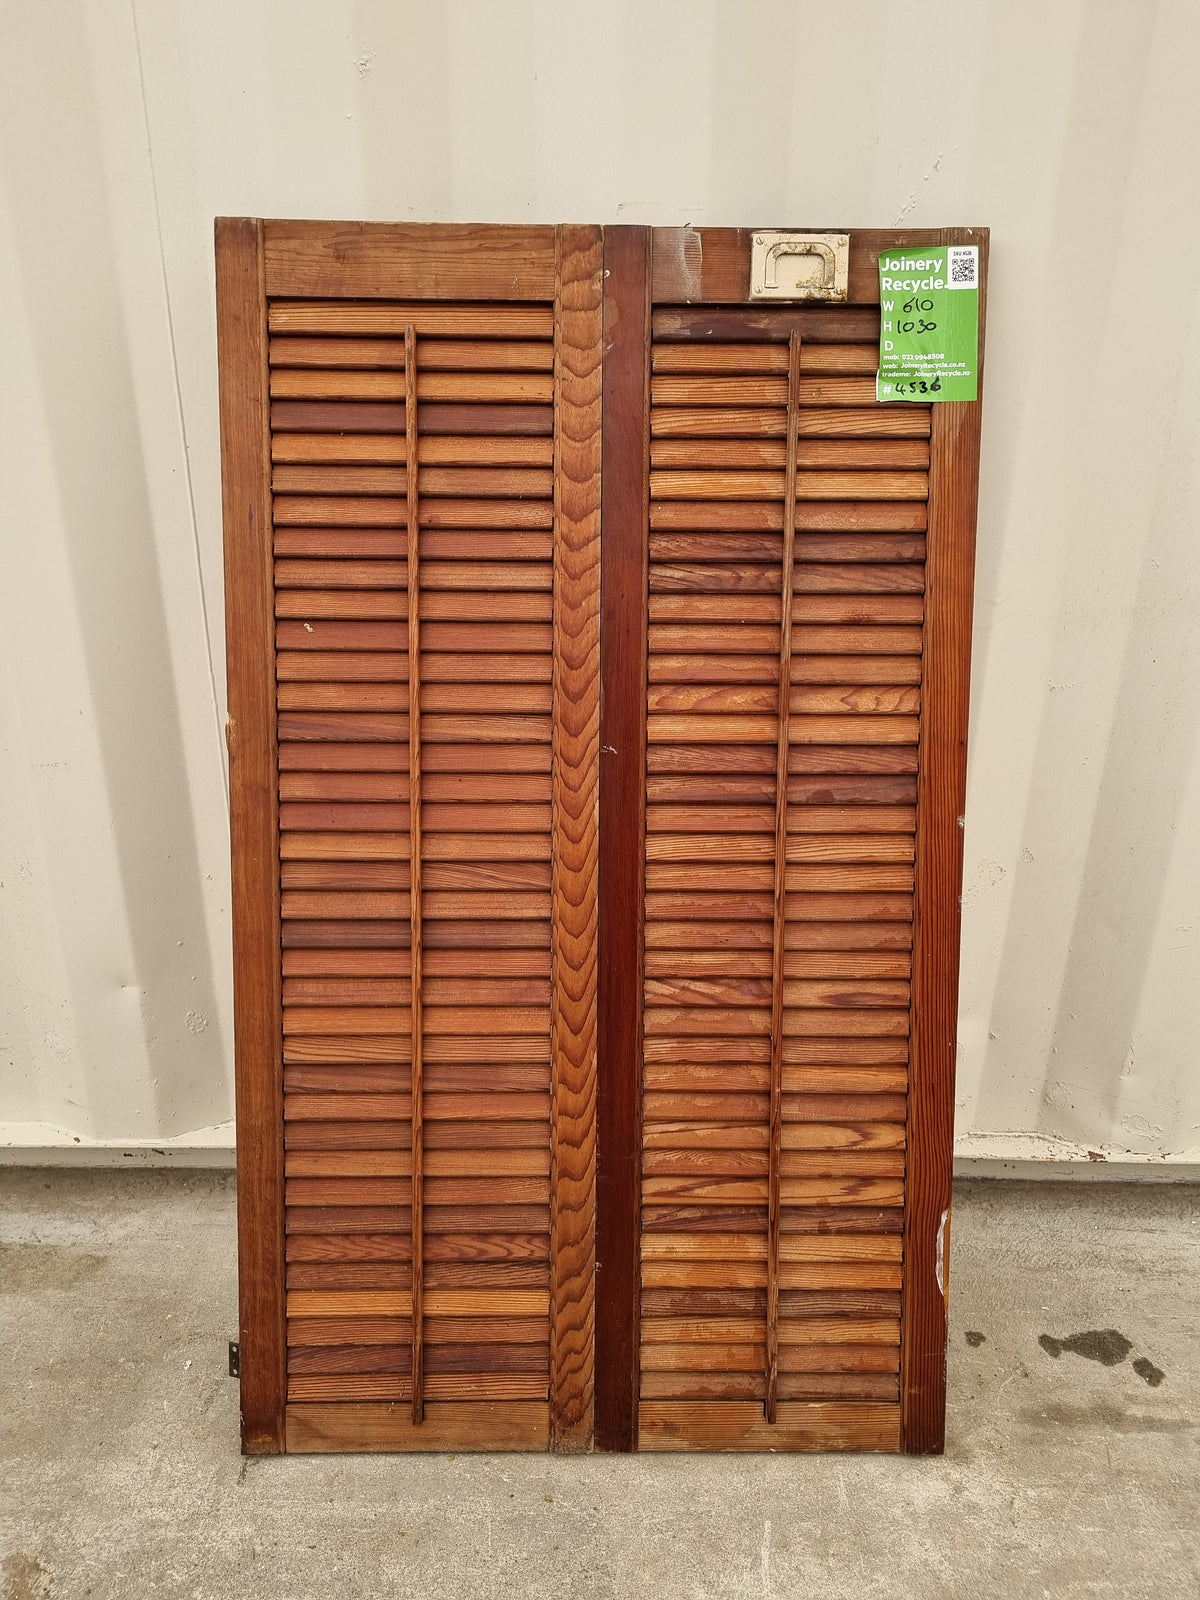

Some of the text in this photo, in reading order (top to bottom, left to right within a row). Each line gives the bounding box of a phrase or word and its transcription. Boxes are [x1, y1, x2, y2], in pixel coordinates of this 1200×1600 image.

[881, 256, 943, 273] Joinery
[883, 297, 933, 313] W 610
[883, 319, 937, 334] H 1030
[884, 340, 893, 351] D
[883, 384, 892, 395] #
